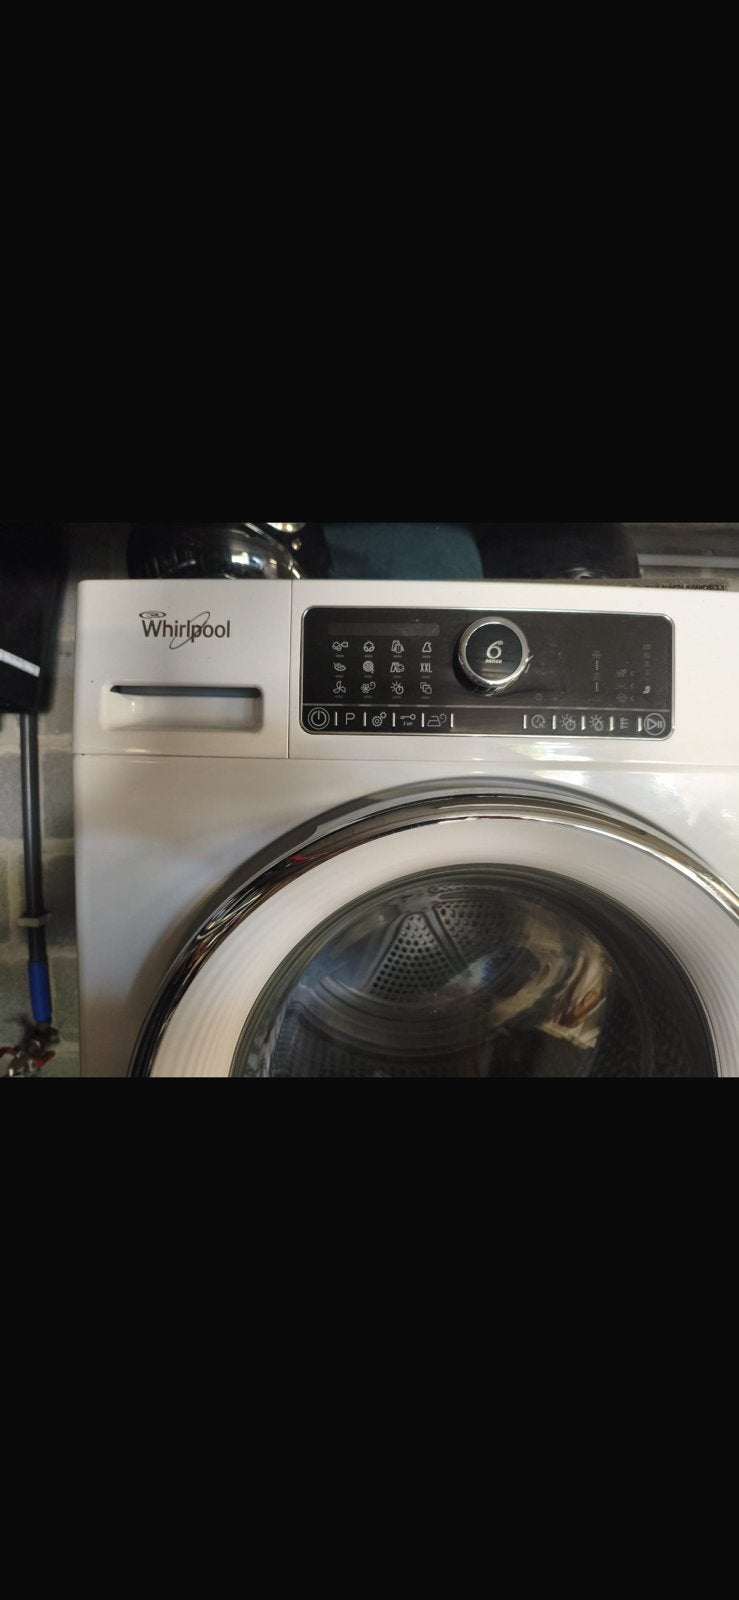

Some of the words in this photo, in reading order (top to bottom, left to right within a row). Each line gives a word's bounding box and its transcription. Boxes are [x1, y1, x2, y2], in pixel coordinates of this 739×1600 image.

[141, 620, 231, 643] Whirlpool
[419, 662, 433, 673] XXL
[345, 712, 356, 725] P
